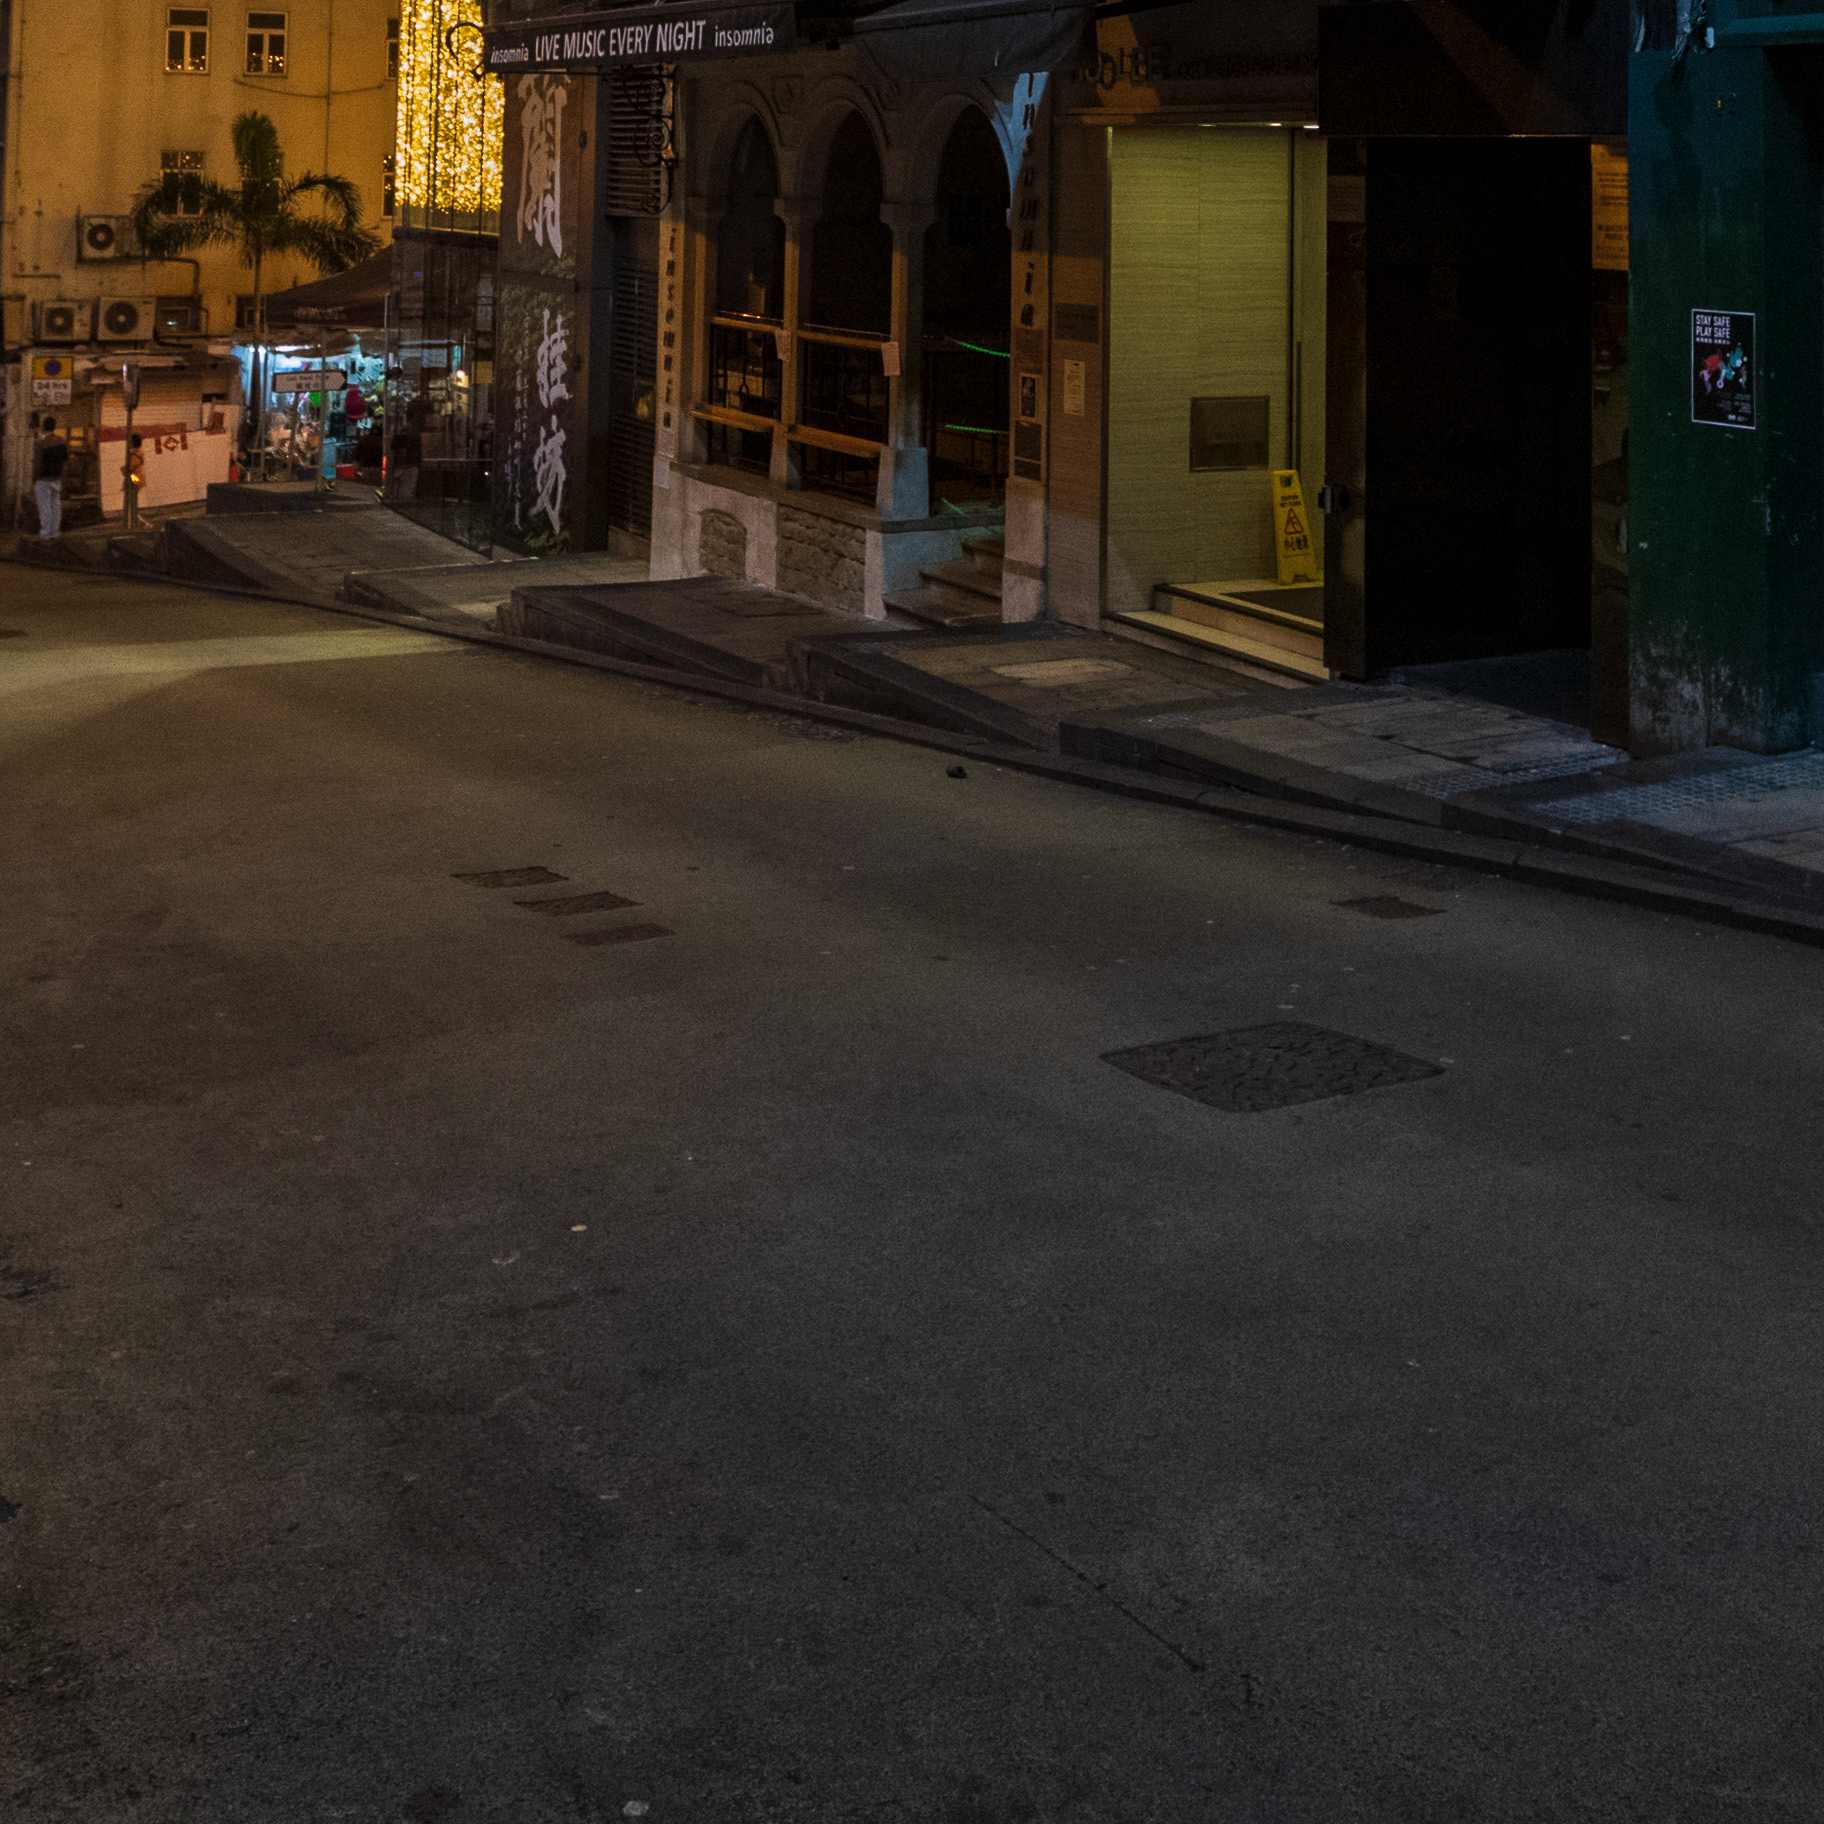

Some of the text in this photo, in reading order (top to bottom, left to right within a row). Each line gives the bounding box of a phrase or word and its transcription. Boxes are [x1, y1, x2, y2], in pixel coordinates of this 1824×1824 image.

[490, 19, 776, 65] insomnia LIVE MUSIC EVERY NIGHT insomnia
[1713, 315, 1731, 328] SAFE
[1713, 326, 1731, 339] SAFE
